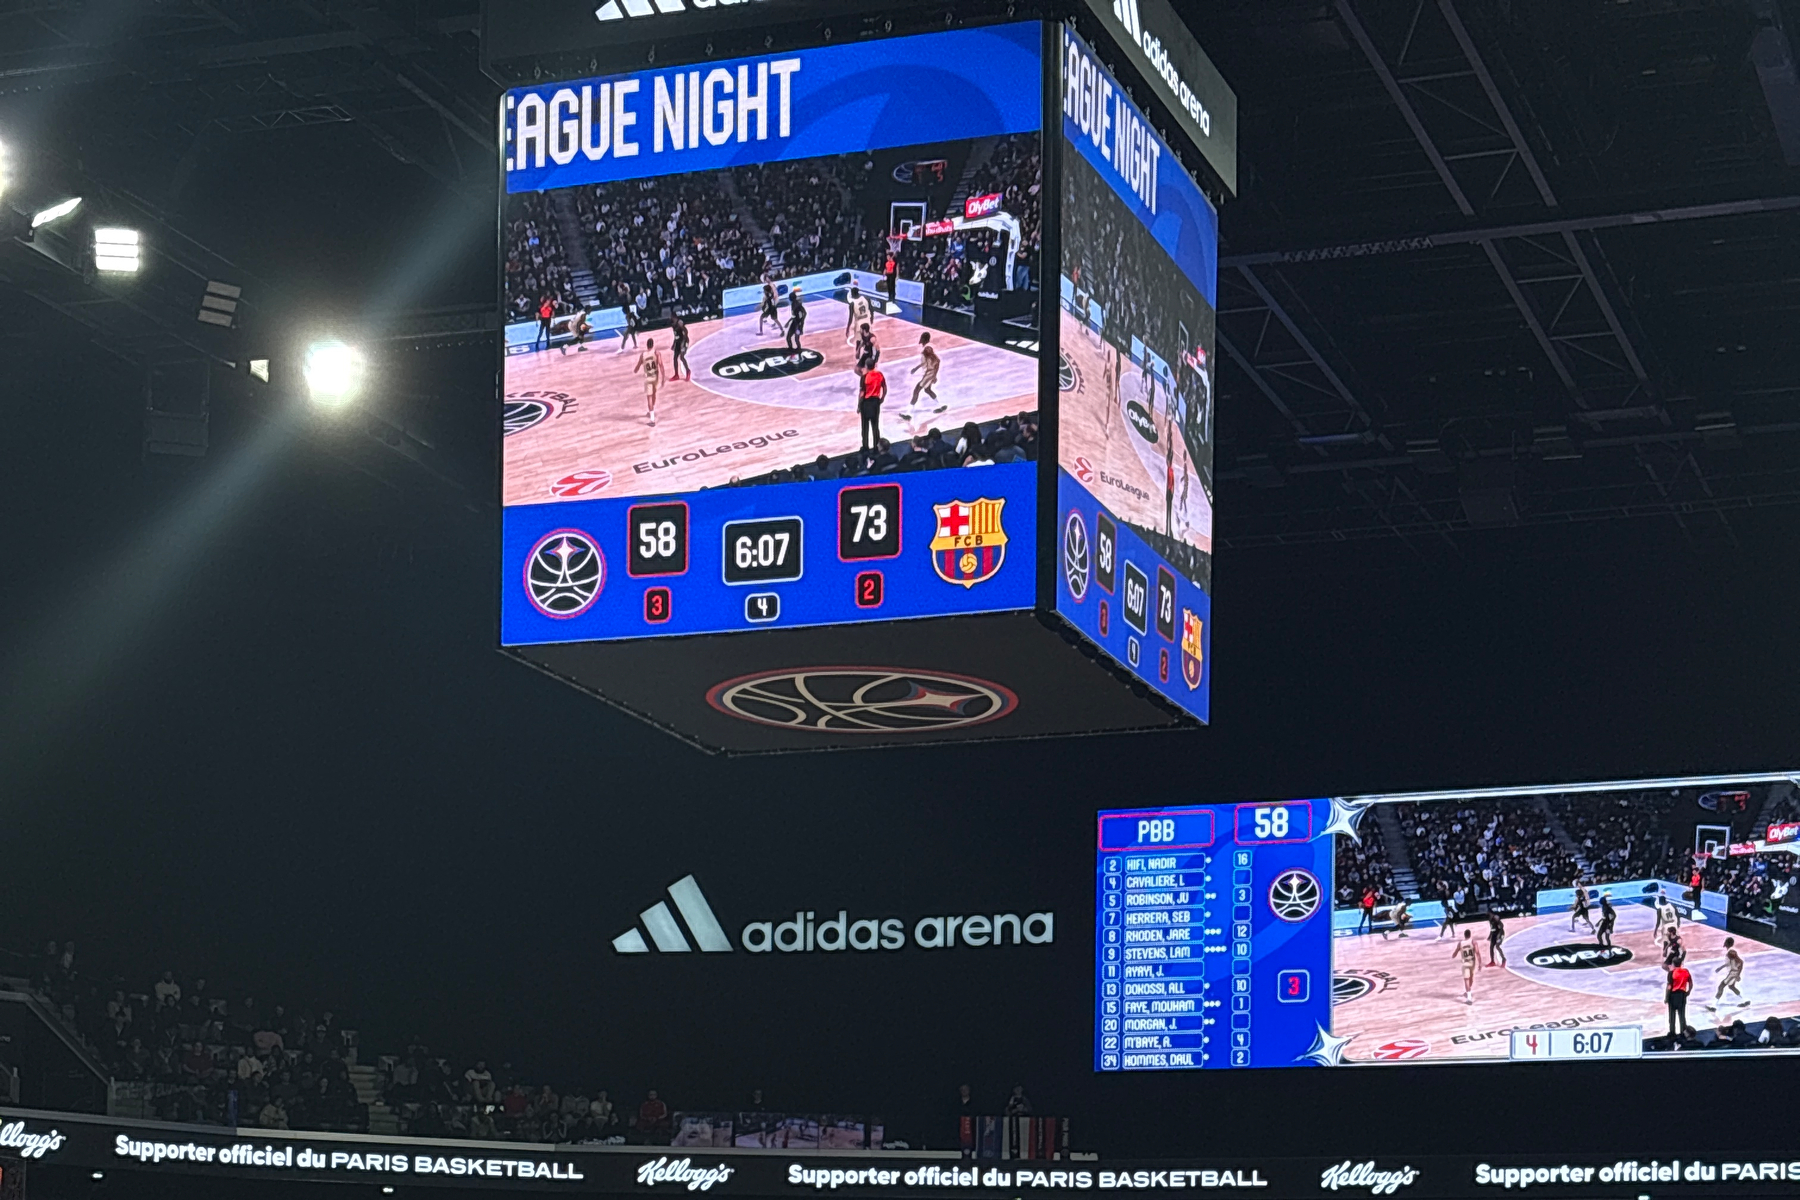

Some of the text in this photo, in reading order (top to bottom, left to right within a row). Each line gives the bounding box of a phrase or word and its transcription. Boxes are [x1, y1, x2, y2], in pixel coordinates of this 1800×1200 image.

[1143, 30, 1210, 137] adidas arena
[653, 58, 801, 153] NIGHT
[1064, 34, 1160, 215] AGUE NIGHT
[632, 428, 799, 475] EuroLeague
[1100, 471, 1150, 501] EuroLeague
[850, 504, 887, 543] 73
[639, 521, 676, 558] 58
[735, 532, 790, 569] 6:07
[1099, 532, 1112, 574] 58
[863, 579, 875, 600] 2
[1127, 578, 1145, 618] 6:07
[651, 594, 663, 616] 3
[757, 597, 768, 617] 4
[1160, 585, 1172, 623] 73
[1138, 819, 1175, 843] PBB
[1254, 807, 1289, 838] 58
[1109, 860, 1116, 871] 2
[1148, 857, 1177, 870] NADIR
[1237, 854, 1248, 864] 16
[1109, 878, 1116, 889] 4
[1109, 889, 1246, 907] 5 ROBINSON, JU 3
[1109, 914, 1116, 925] 7
[1172, 910, 1191, 922] SEB
[741, 910, 1054, 953] adidas arena
[1108, 925, 1247, 943] 8 RHODEN, JARE 12
[1108, 944, 1247, 961] 9 STEVENS, LAM 10
[1107, 966, 1116, 977] 11
[1106, 984, 1117, 995] 13
[1125, 982, 1168, 996] DOKOSSI,
[1236, 980, 1247, 991] 10
[1288, 976, 1300, 995] 3
[1105, 1002, 1116, 1013] 15
[1125, 1001, 1150, 1014] FAYE,
[1238, 998, 1243, 1009] 1
[1105, 1020, 1117, 1031] 20
[1105, 1038, 1117, 1049] 22
[1237, 1033, 1244, 1045] 4
[1526, 1032, 1614, 1055] 4 6:07
[1104, 1055, 1117, 1067] 34
[1237, 1051, 1243, 1062] 2
[115, 1134, 584, 1180] Supporter officiel du PARIS BASKETBALL
[637, 1157, 731, 1191] Kellogg's
[788, 1164, 1268, 1191] Supporter officiel du PARIS BASKETBALL
[1321, 1160, 1417, 1194] Kellogg's
[1475, 1160, 1800, 1189] Supporter officiel du PARIS
